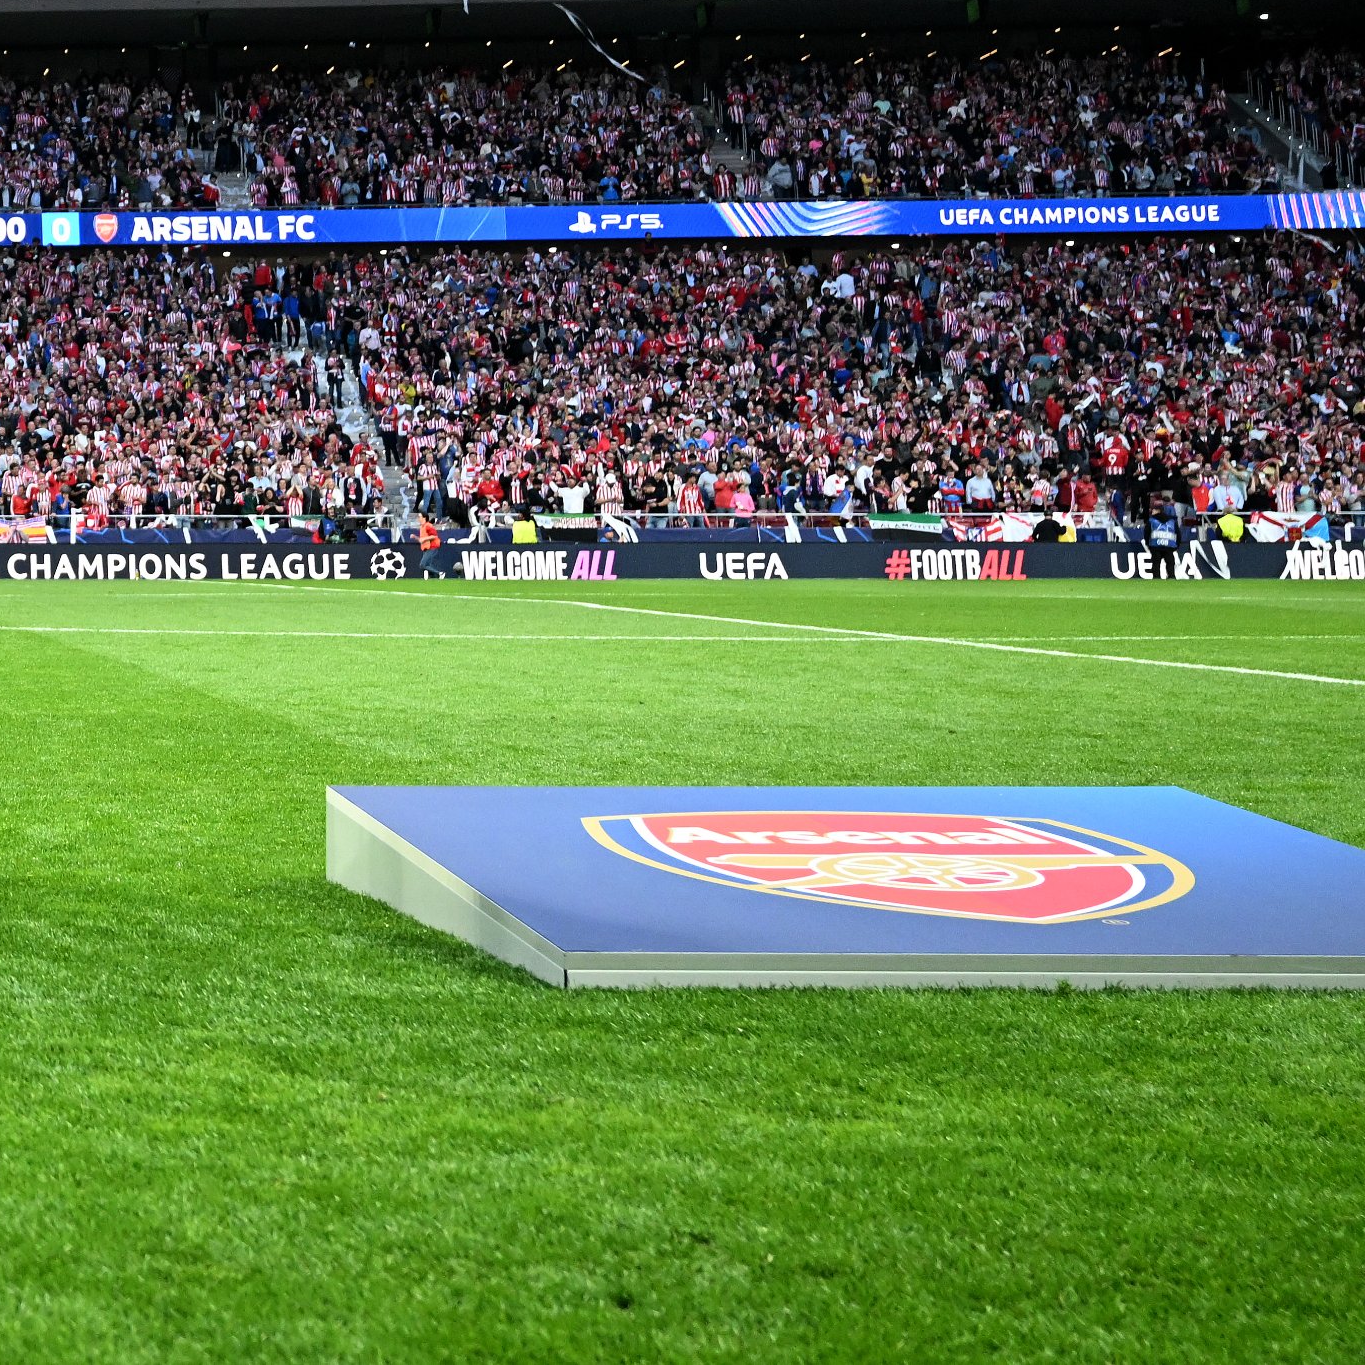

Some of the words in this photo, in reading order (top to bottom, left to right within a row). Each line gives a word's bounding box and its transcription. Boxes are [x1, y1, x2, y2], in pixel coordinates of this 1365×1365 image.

[52, 218, 69, 242] 0
[130, 215, 273, 242] ARSENAL
[277, 214, 316, 240] FC
[939, 209, 994, 227] UEFA
[999, 205, 1129, 226] CHAMPIONS
[1132, 204, 1220, 223] LEAGUE
[1108, 453, 1117, 466] 9
[7, 552, 208, 580] CHAMPIONS
[221, 552, 352, 580] LEAGUE
[462, 549, 568, 580] WELCOME
[570, 549, 618, 580] ALL
[699, 551, 788, 580] UEFA
[884, 548, 1027, 580] #FOOTBALL
[665, 823, 1057, 847] Arsenal
